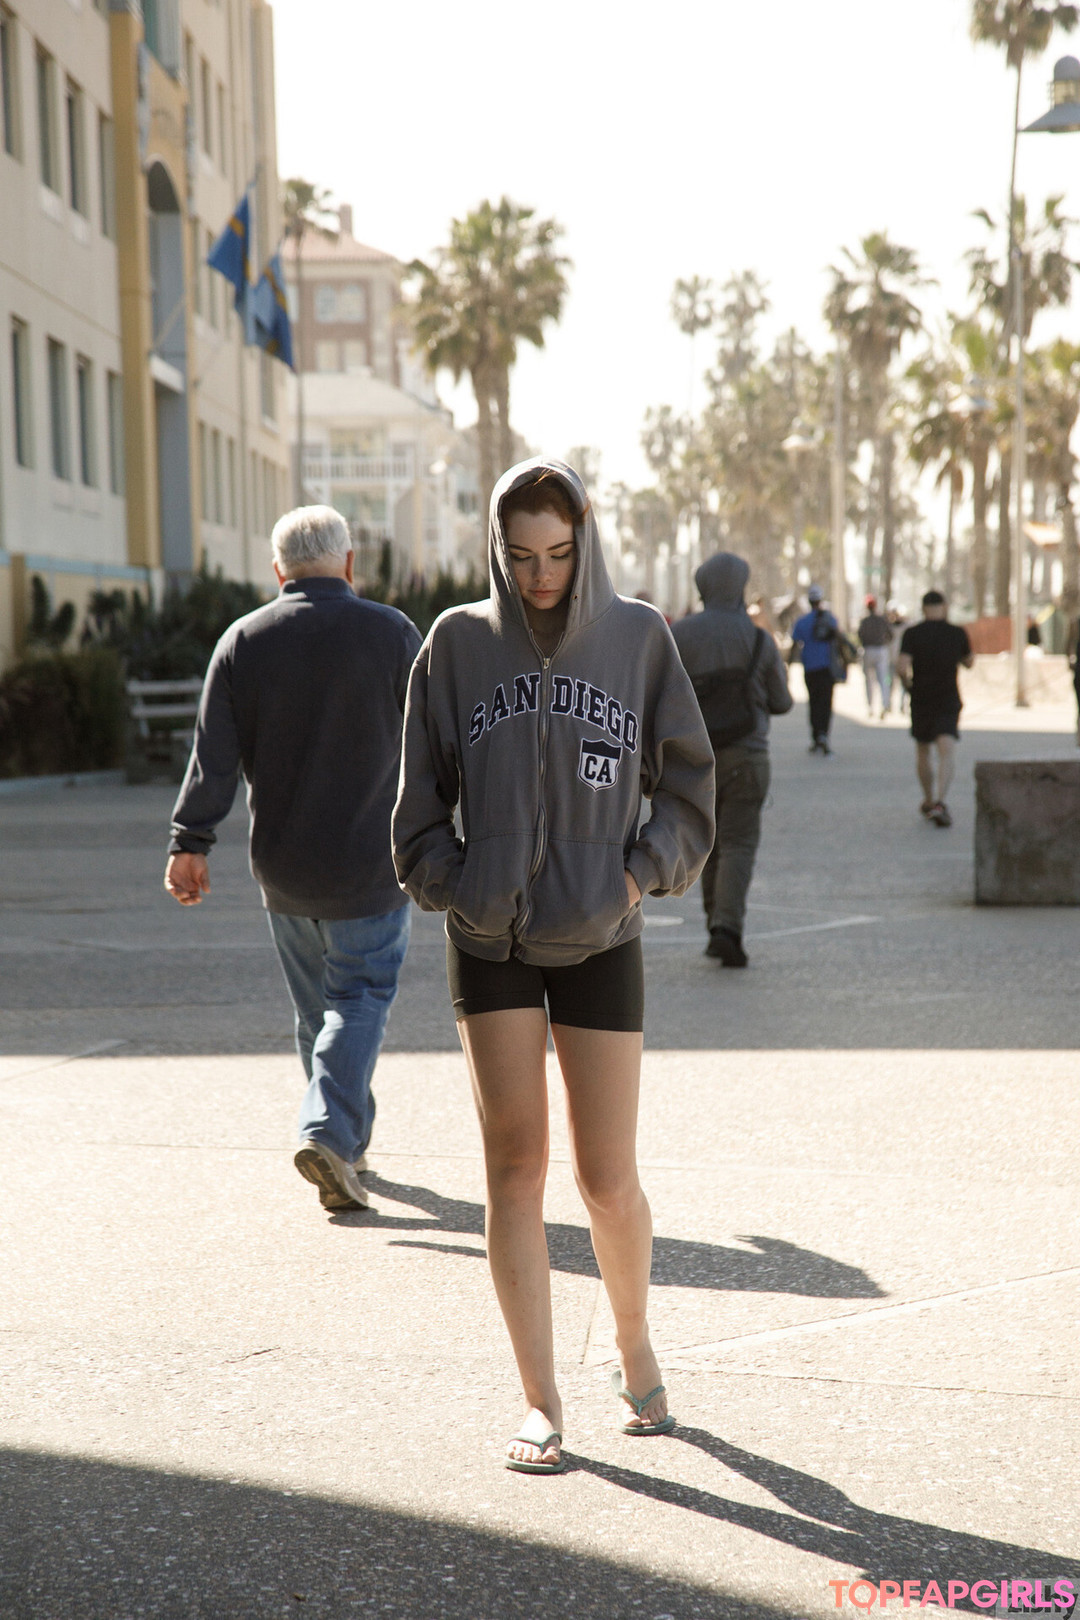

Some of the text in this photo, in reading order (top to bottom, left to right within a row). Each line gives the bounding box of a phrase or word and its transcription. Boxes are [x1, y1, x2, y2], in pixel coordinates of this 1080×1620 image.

[469, 672, 639, 753] SAN DIEGO
[584, 755, 613, 784] CA
